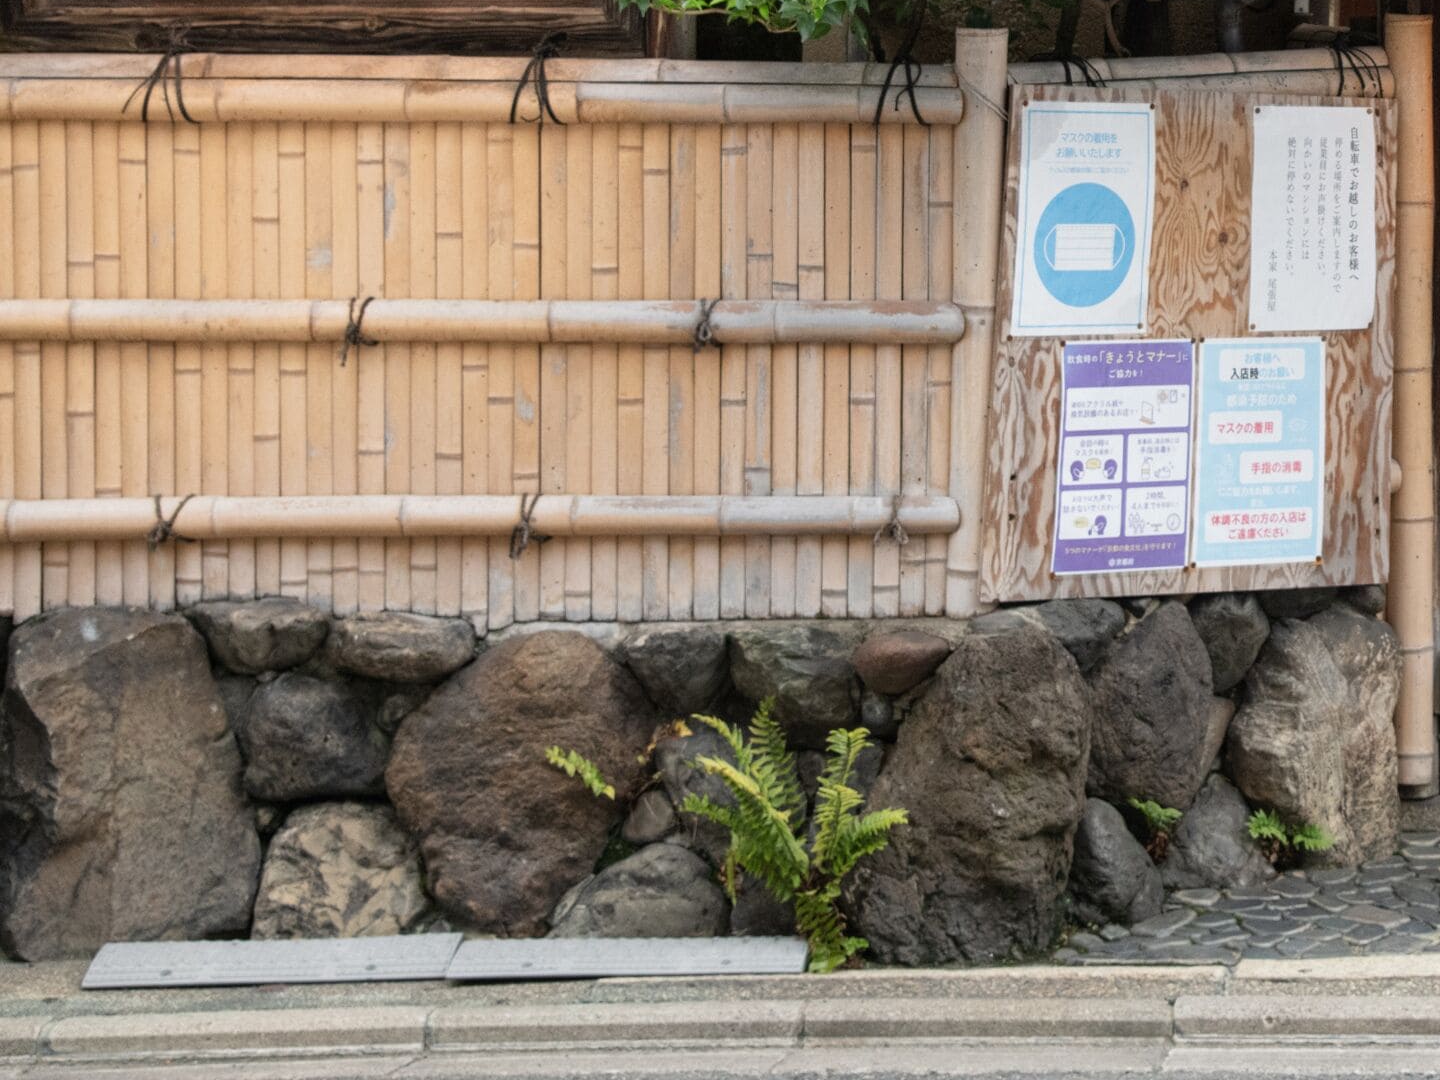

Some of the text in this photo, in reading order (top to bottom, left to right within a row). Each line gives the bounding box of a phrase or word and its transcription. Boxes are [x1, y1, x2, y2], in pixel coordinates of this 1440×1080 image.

[1348, 126, 1360, 281] 自転車でお越しのお客様へ
[1217, 421, 1275, 435] マスクの着用
[1211, 511, 1307, 527] 体調不良の方の入店は
